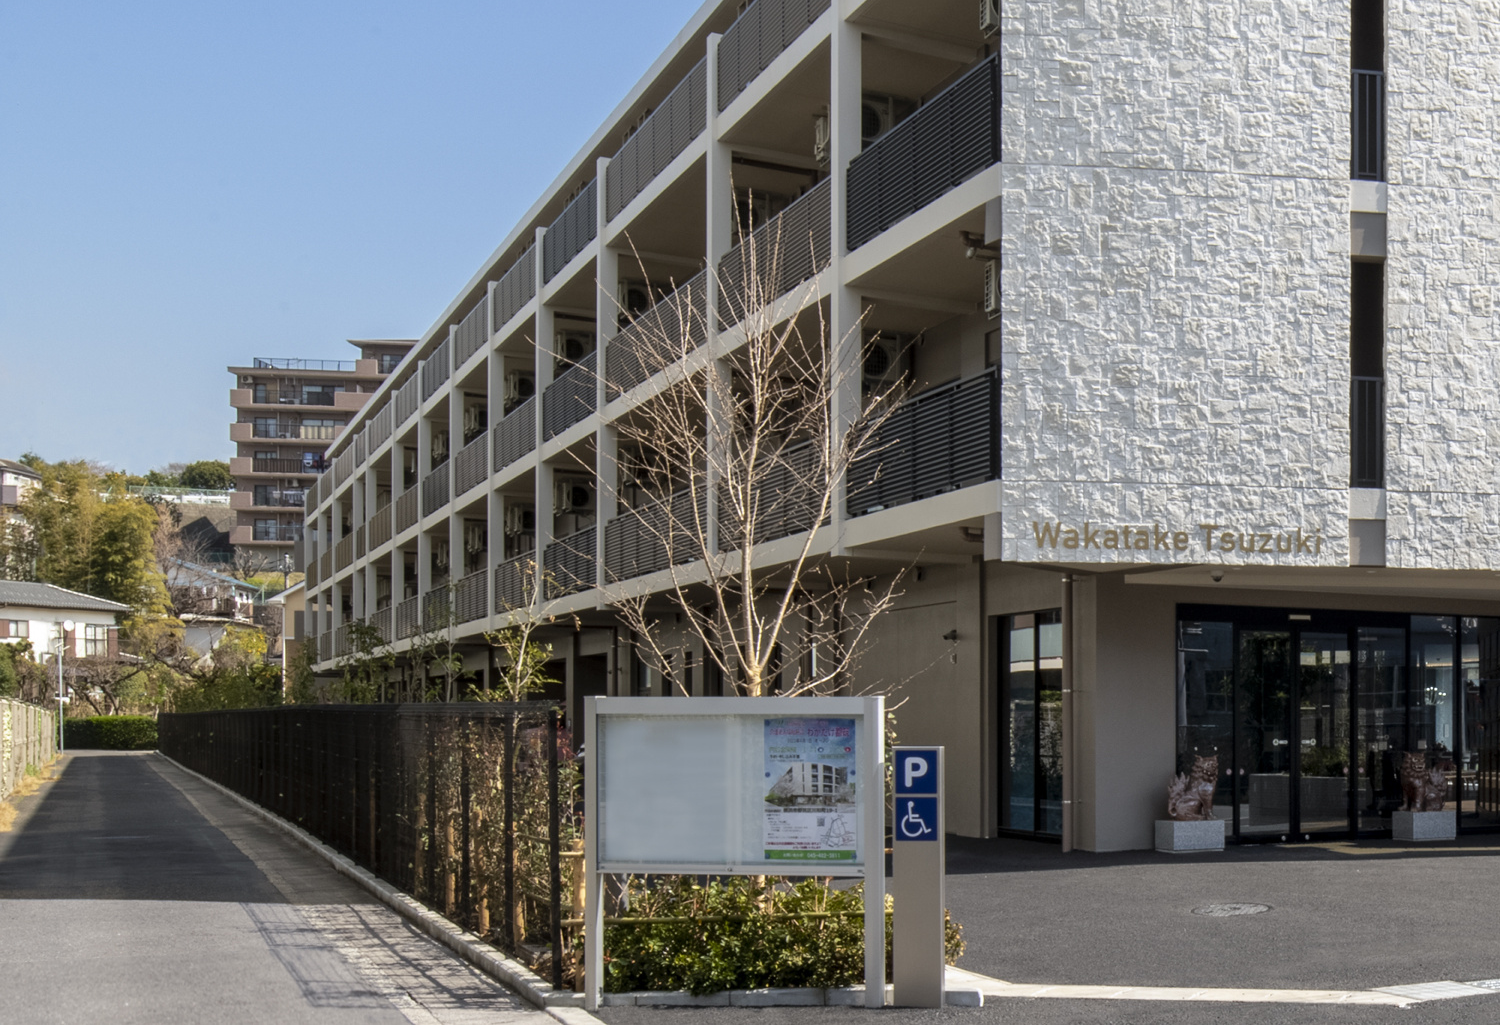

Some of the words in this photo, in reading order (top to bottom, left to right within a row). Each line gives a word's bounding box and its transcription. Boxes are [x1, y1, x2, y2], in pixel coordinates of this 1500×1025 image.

[1033, 521, 1190, 551] Wakatake
[1199, 524, 1323, 554] Tsuzuki
[904, 756, 928, 788] P
